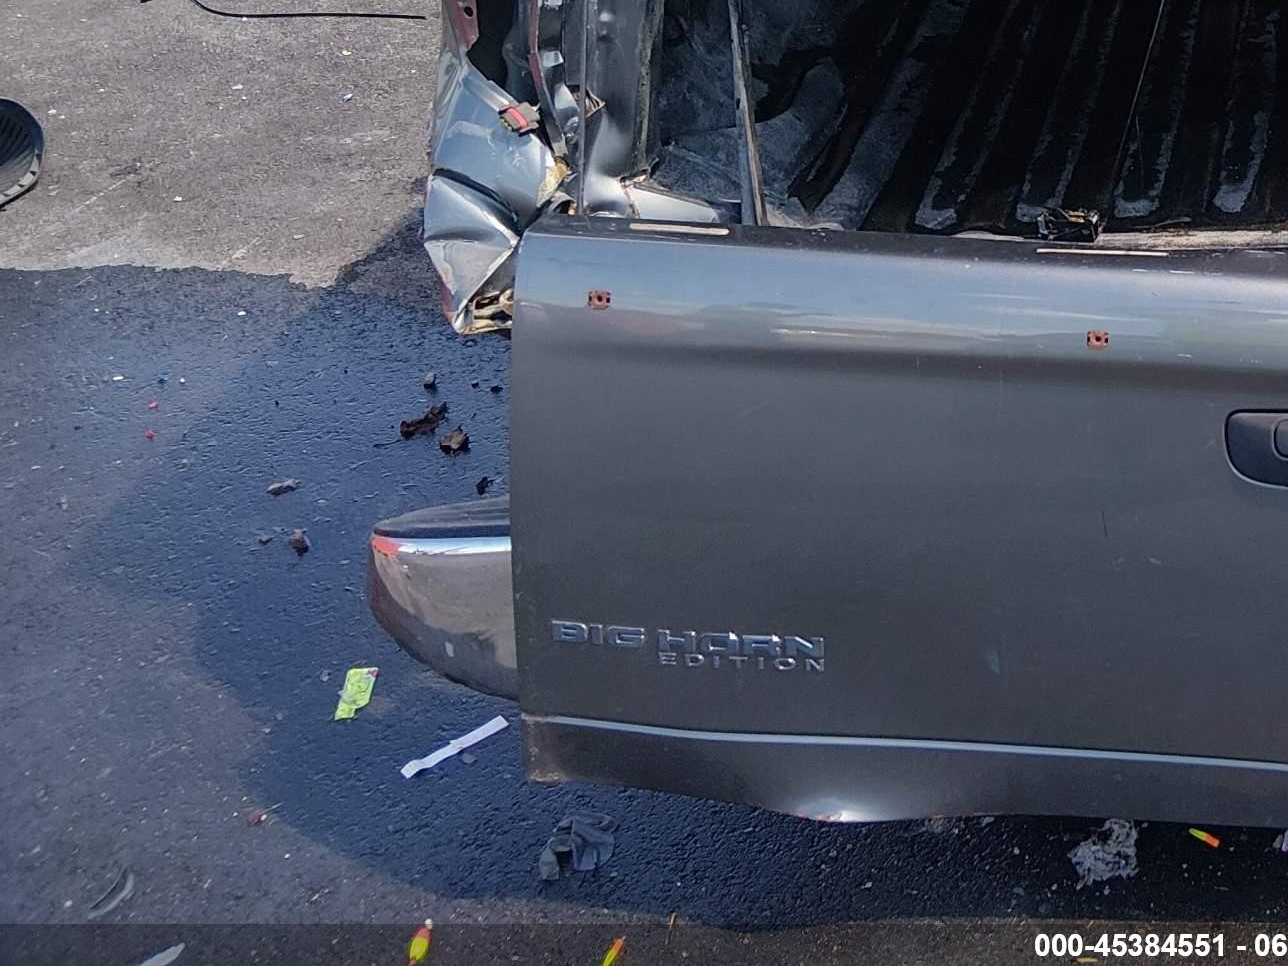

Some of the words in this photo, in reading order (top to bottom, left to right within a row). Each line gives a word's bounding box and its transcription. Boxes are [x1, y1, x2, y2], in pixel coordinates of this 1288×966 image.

[550, 618, 647, 649] BIG
[656, 628, 825, 658] HORN
[657, 651, 825, 672] EDITION
